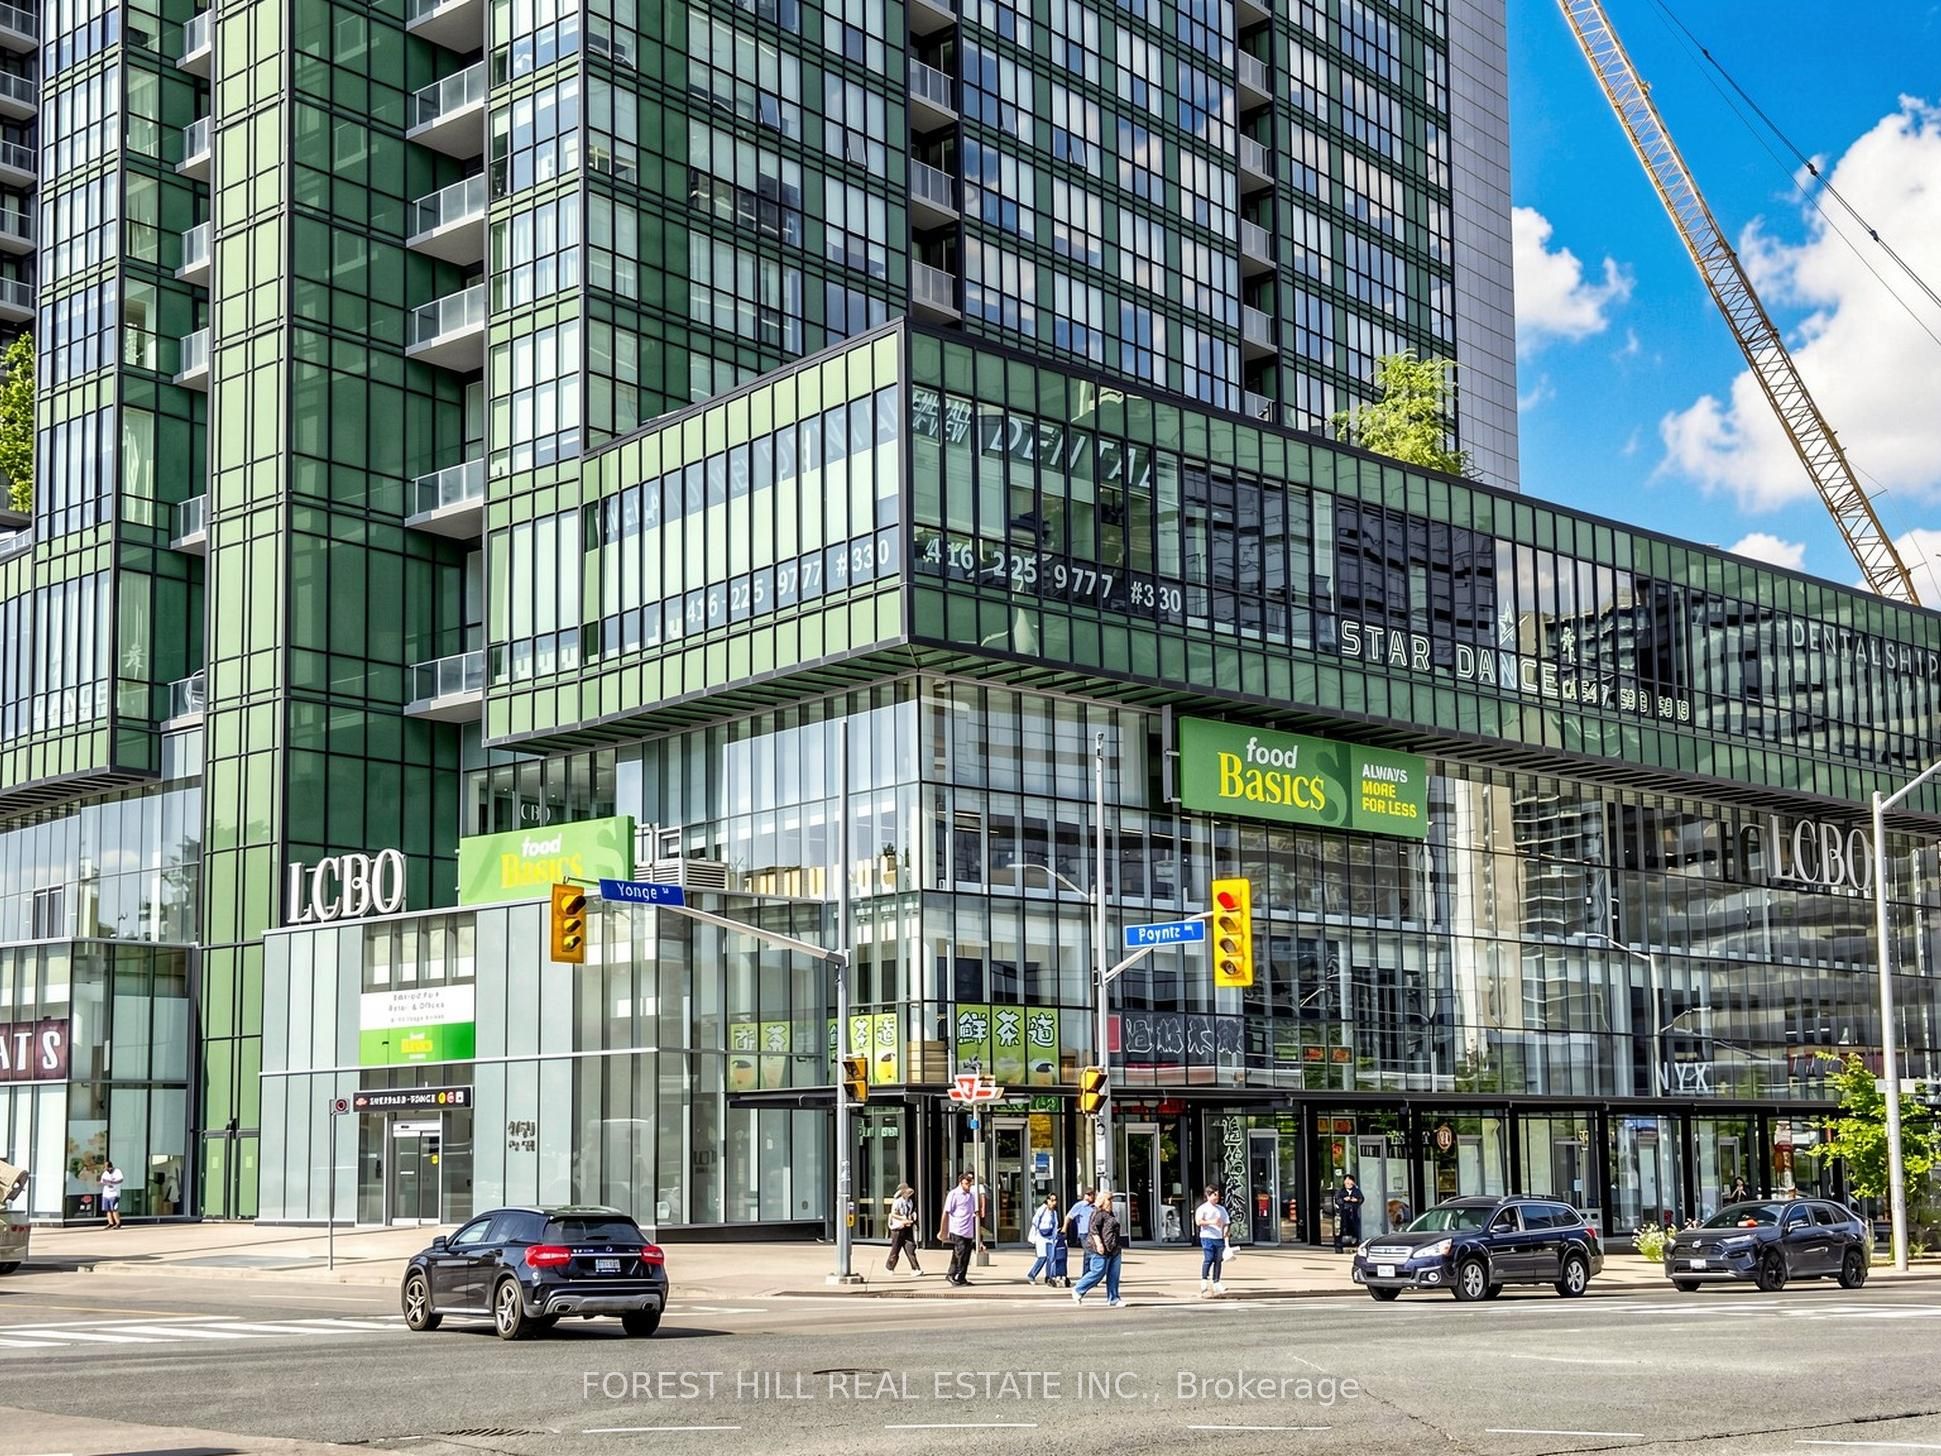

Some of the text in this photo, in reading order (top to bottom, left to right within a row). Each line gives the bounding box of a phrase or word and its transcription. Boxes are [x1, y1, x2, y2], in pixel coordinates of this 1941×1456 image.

[778, 559, 822, 596] 9777
[836, 539, 890, 578] #330
[994, 550, 1038, 584] 225
[1053, 563, 1113, 599] 9777
[1130, 580, 1182, 613] #330
[1341, 619, 1431, 672] STAR
[1456, 643, 1559, 697] DANCE
[1791, 620, 1939, 679] DENTALSHIP
[1246, 736, 1299, 769] food
[1362, 763, 1408, 784] ALWAYS
[1362, 780, 1397, 799] MORE
[1362, 797, 1417, 818] FOR LESS
[522, 832, 563, 857] food
[1769, 814, 1873, 891] LCBO
[287, 848, 405, 924] LCBO
[616, 882, 658, 902] Yonge
[1138, 926, 1181, 944] Poyntz
[957, 1009, 1055, 1048] 鮮茶道
[1655, 1061, 1709, 1093] NYX
